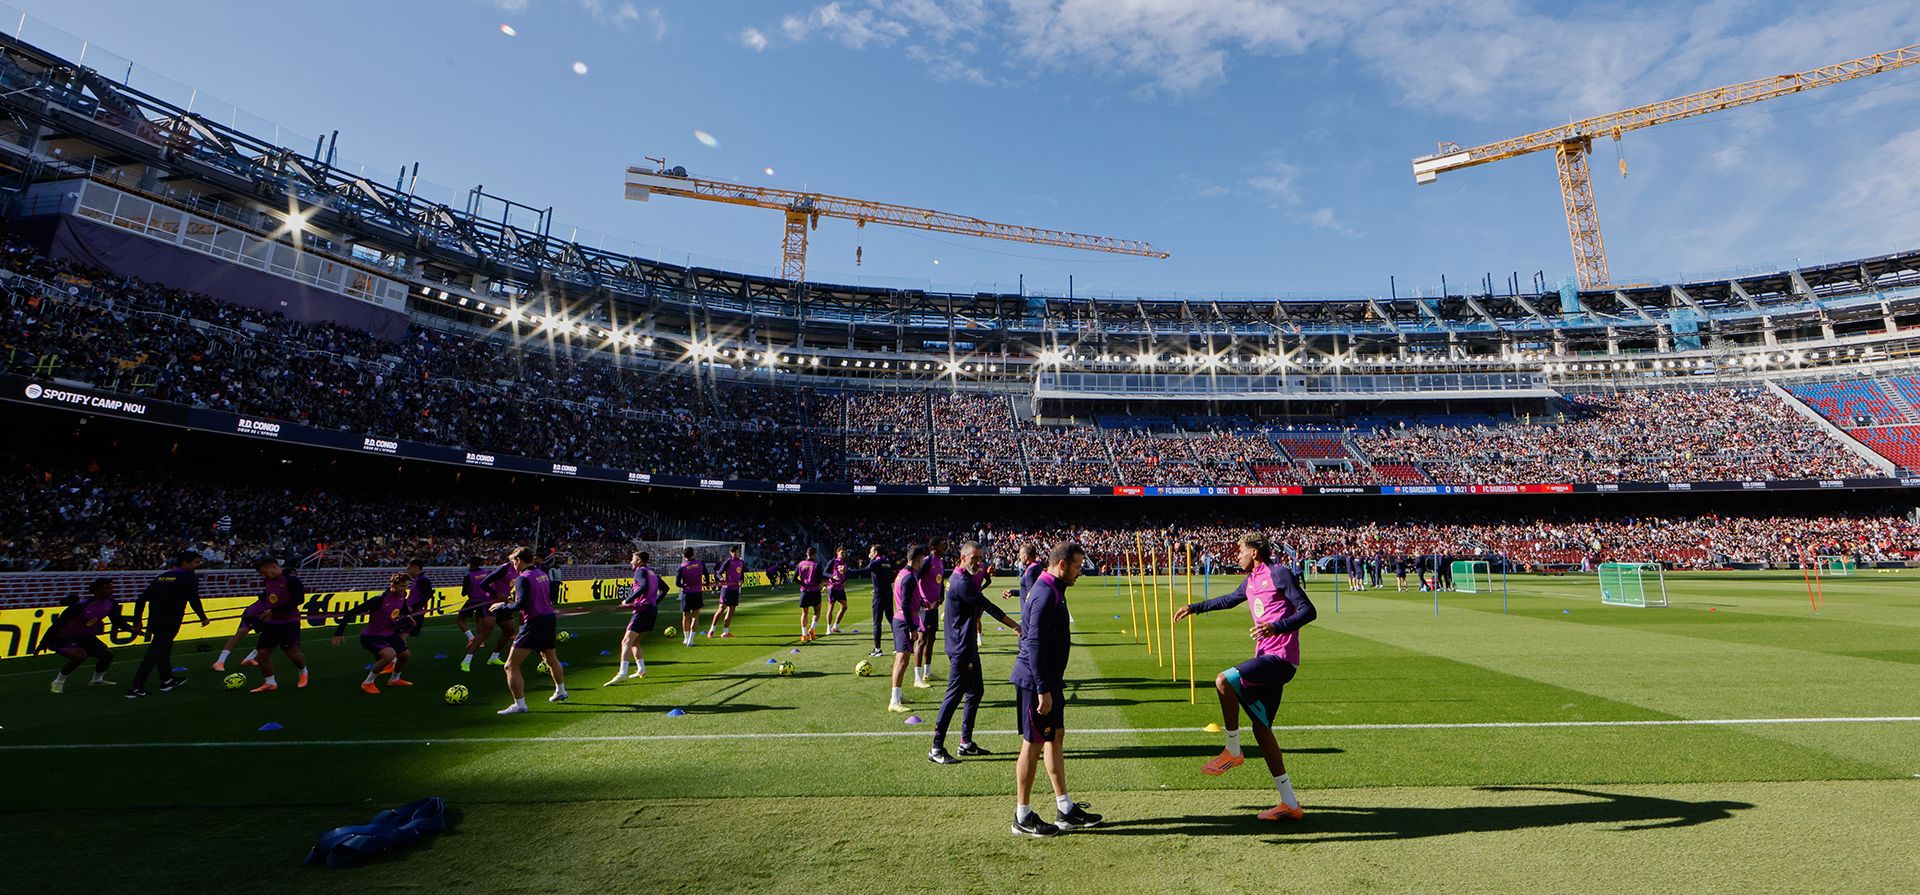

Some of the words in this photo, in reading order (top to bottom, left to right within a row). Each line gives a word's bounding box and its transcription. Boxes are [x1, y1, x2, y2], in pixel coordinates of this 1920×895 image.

[42, 389, 91, 405] SPOTIFY
[91, 397, 122, 410] CAMP
[123, 402, 146, 414] NOU
[253, 421, 280, 432] CONGO
[376, 440, 397, 449] CONGO
